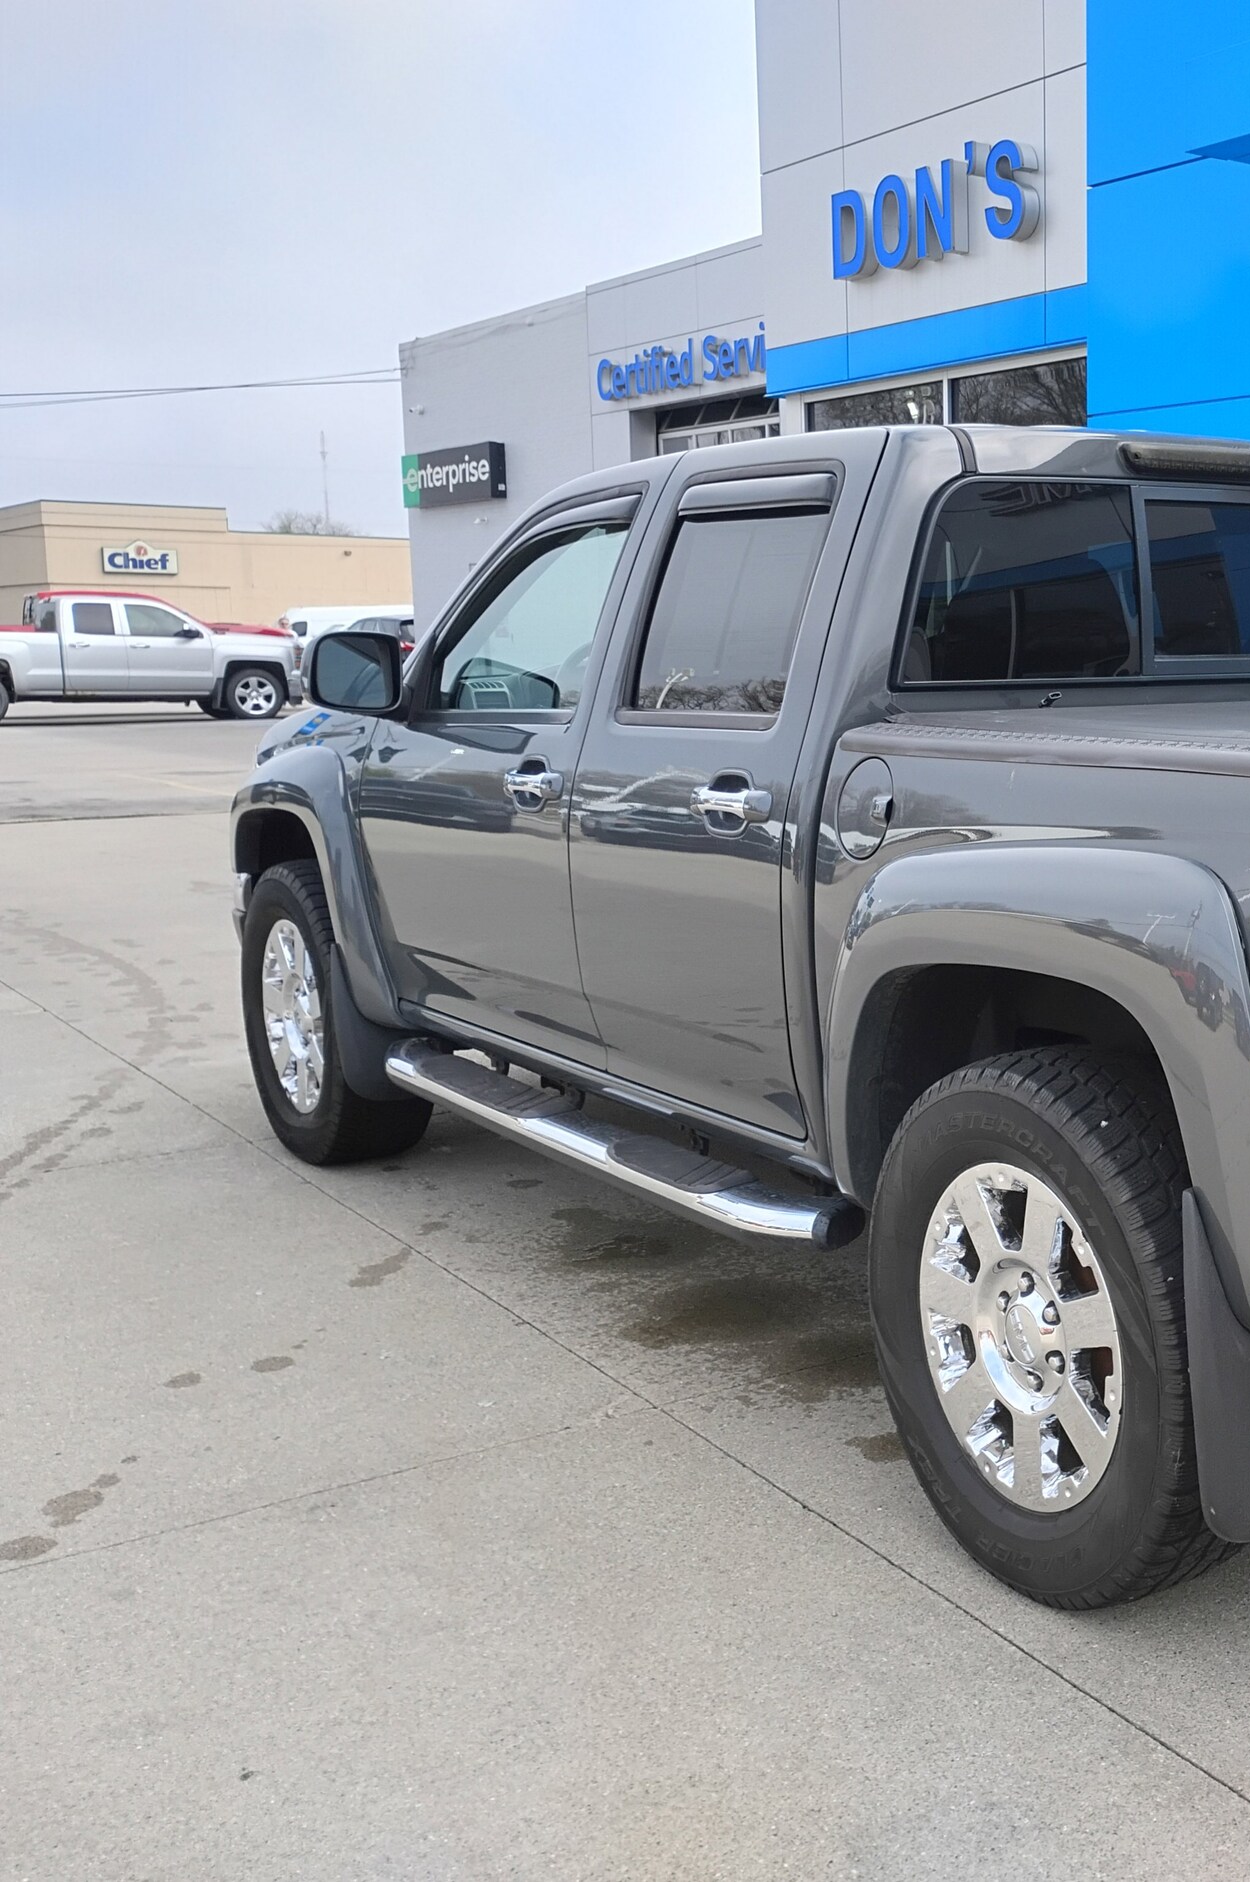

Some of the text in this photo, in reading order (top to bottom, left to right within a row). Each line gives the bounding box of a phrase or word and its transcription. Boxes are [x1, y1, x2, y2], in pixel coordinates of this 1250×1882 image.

[831, 139, 1033, 282] DON'S
[597, 338, 694, 401] Certified
[403, 454, 490, 493] enterprise
[107, 552, 169, 570] Chief
